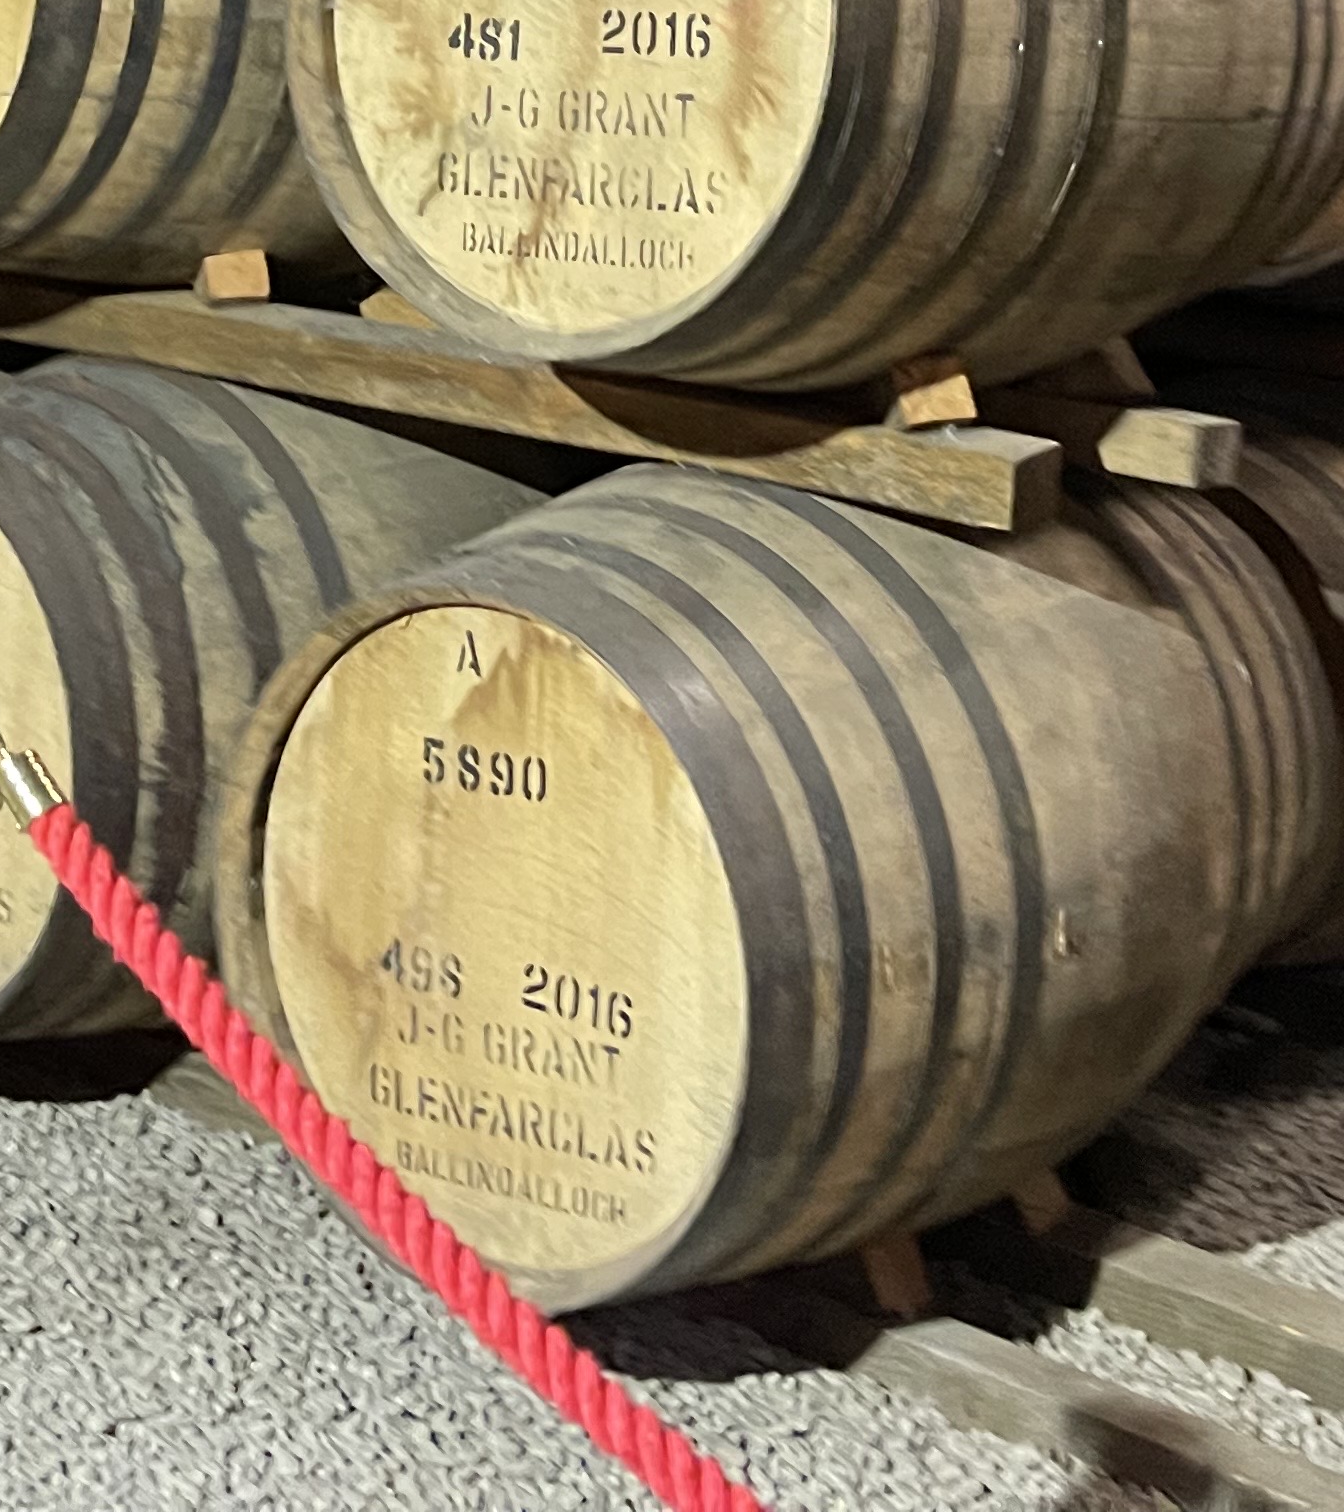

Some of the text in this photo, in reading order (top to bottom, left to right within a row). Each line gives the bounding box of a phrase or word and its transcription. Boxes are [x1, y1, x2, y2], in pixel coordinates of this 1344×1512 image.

[448, 9, 712, 62] 481 2016
[558, 89, 695, 139] GRANT
[437, 150, 725, 215] GLENFARCLAS
[461, 221, 695, 271] BALLINDALLOCH
[457, 630, 482, 678] A
[422, 737, 547, 802] 5890
[520, 963, 634, 1040] 2016
[483, 1021, 621, 1086] GRANT
[369, 1063, 657, 1173] GLENFARCLAS
[396, 1138, 627, 1224] BALLINDALLOCH
